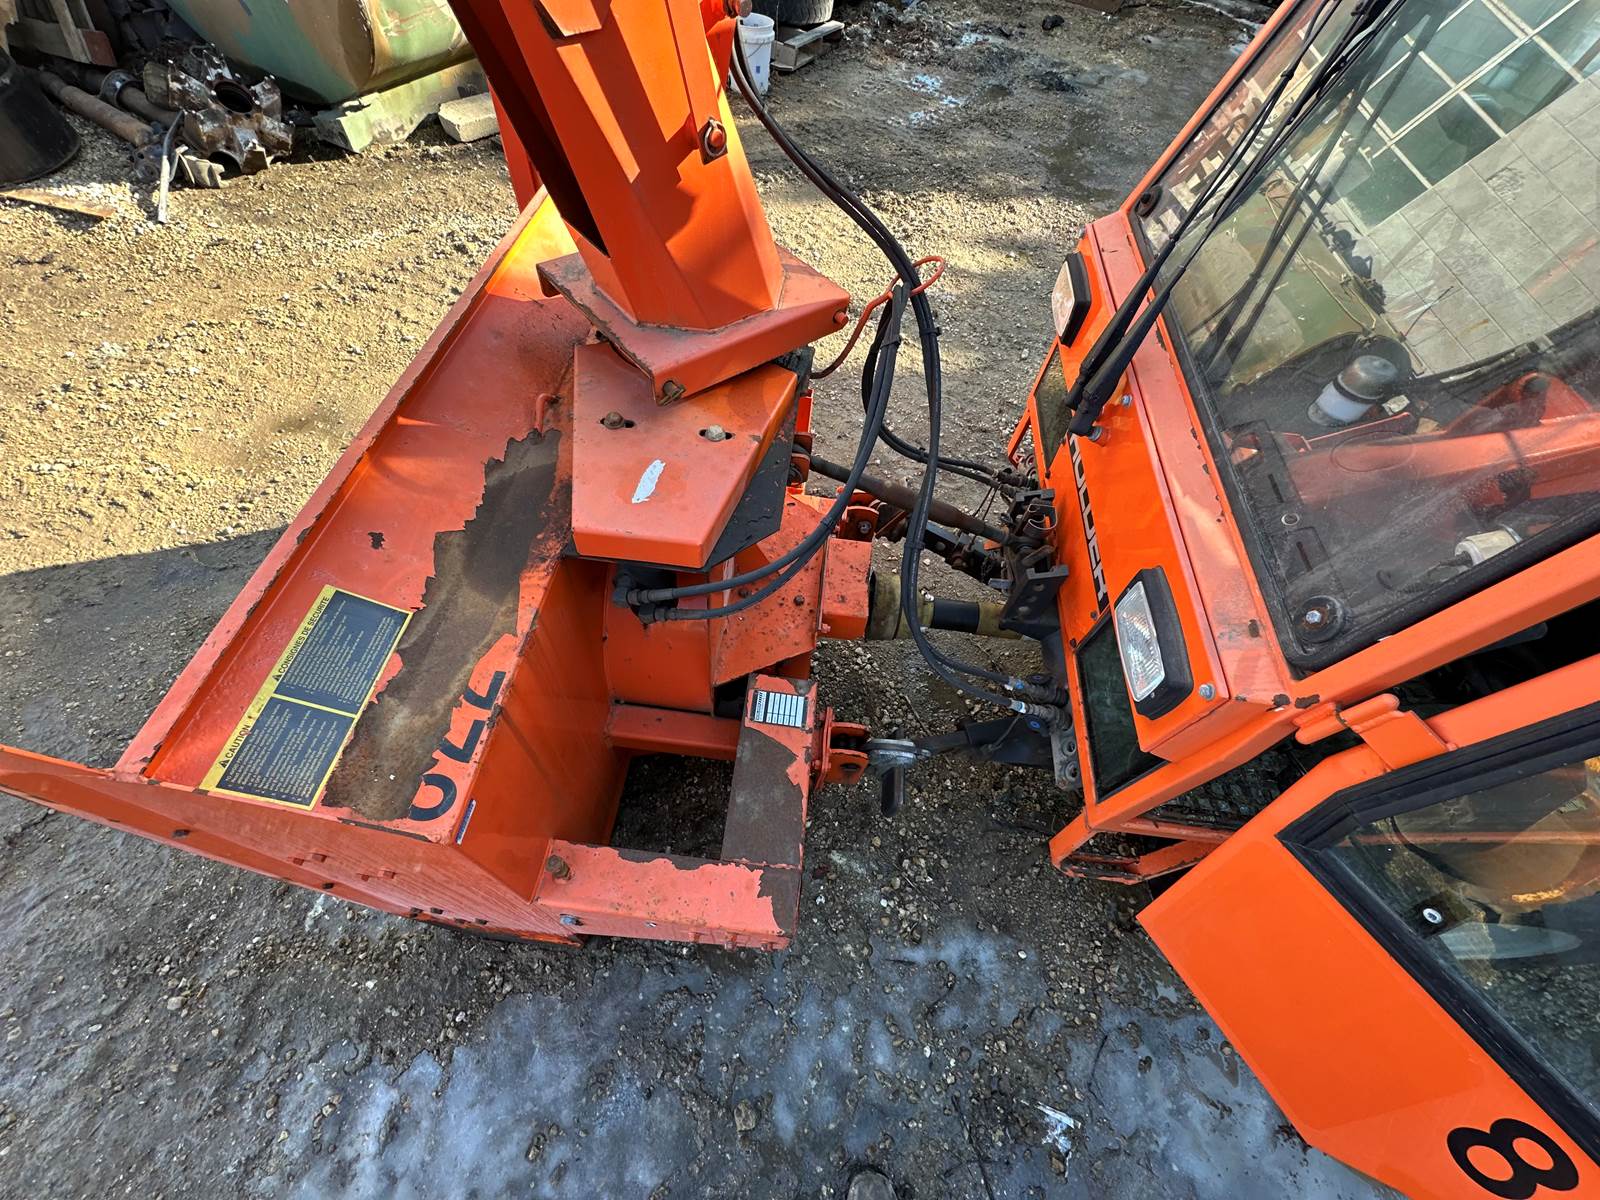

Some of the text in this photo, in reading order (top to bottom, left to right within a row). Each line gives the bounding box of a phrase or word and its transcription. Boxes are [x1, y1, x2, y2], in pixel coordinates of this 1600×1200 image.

[277, 635, 305, 673] CONSIGNES
[300, 627, 310, 635] DE
[224, 724, 251, 758] CAUTION
[1447, 1118, 1579, 1200] 8
